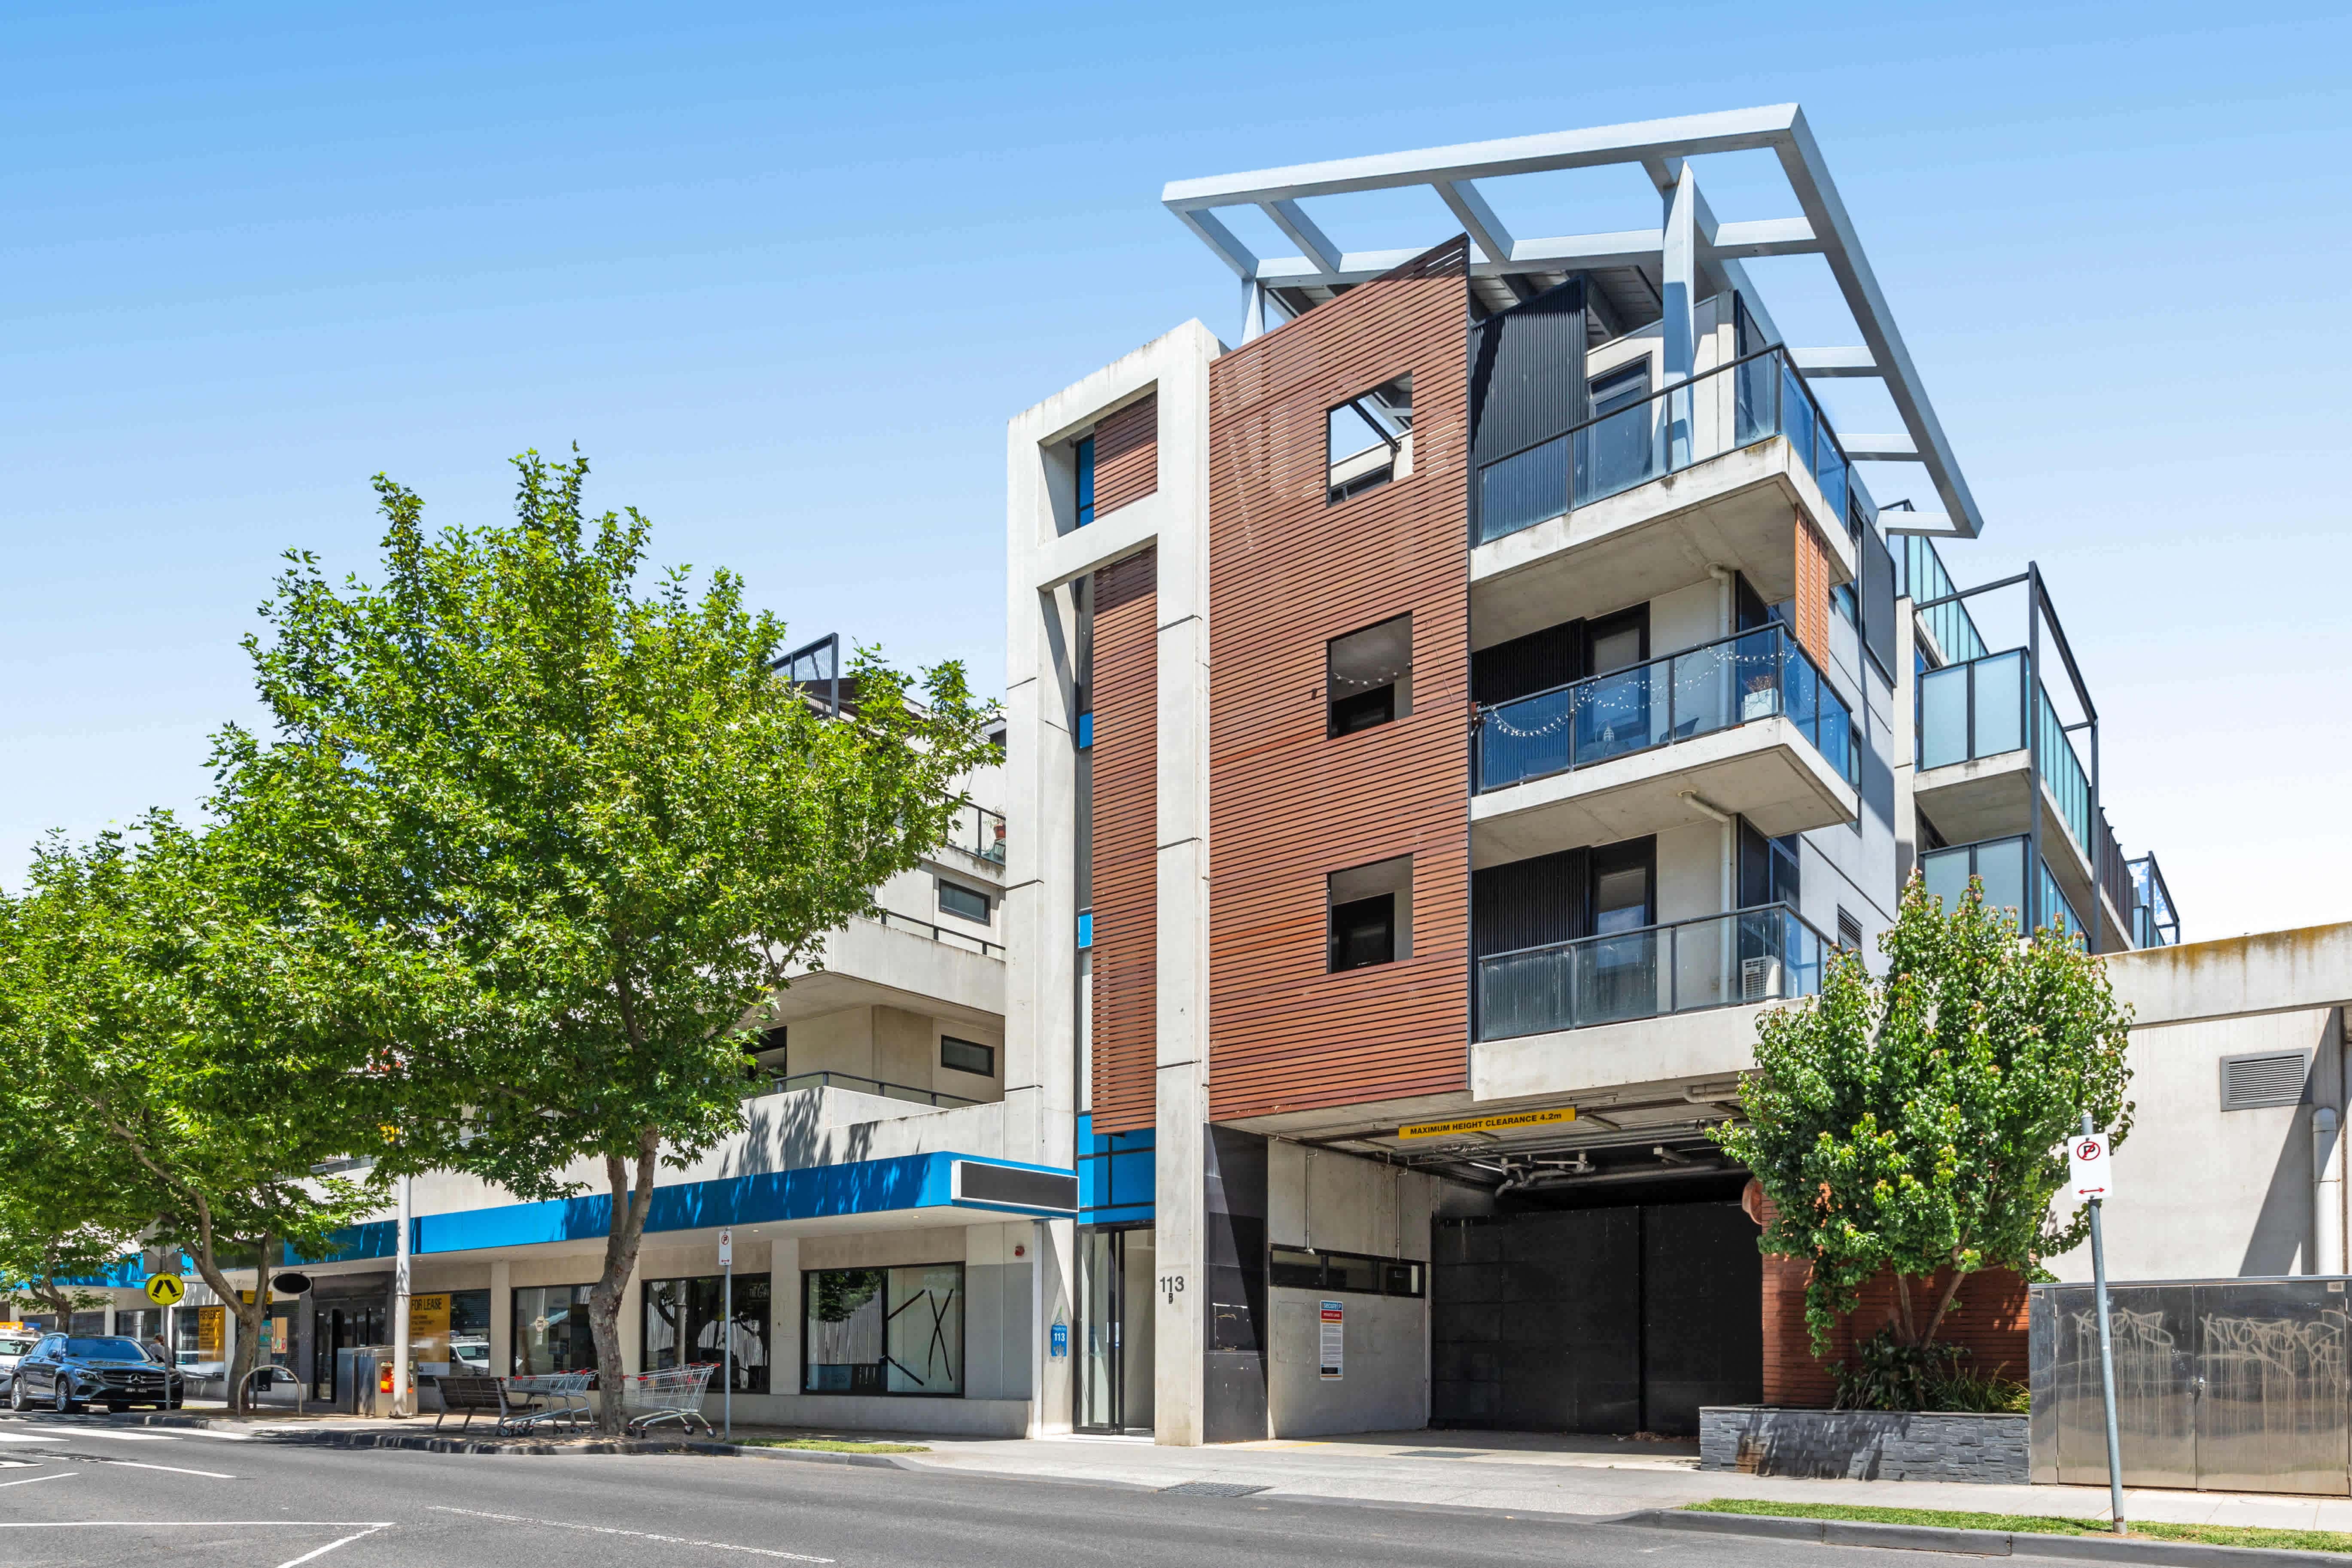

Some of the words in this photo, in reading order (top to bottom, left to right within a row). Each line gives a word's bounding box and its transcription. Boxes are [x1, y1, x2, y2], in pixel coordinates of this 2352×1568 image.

[1410, 1124, 1450, 1135] MAXIMUM
[1452, 1121, 1483, 1130] HEIGHT
[1485, 1115, 1537, 1127] CLEARANCE
[1159, 1276, 1184, 1292] 113
[411, 1299, 422, 1310] FOR
[423, 1298, 441, 1310] LEASE
[1055, 1333, 1065, 1341] 113
